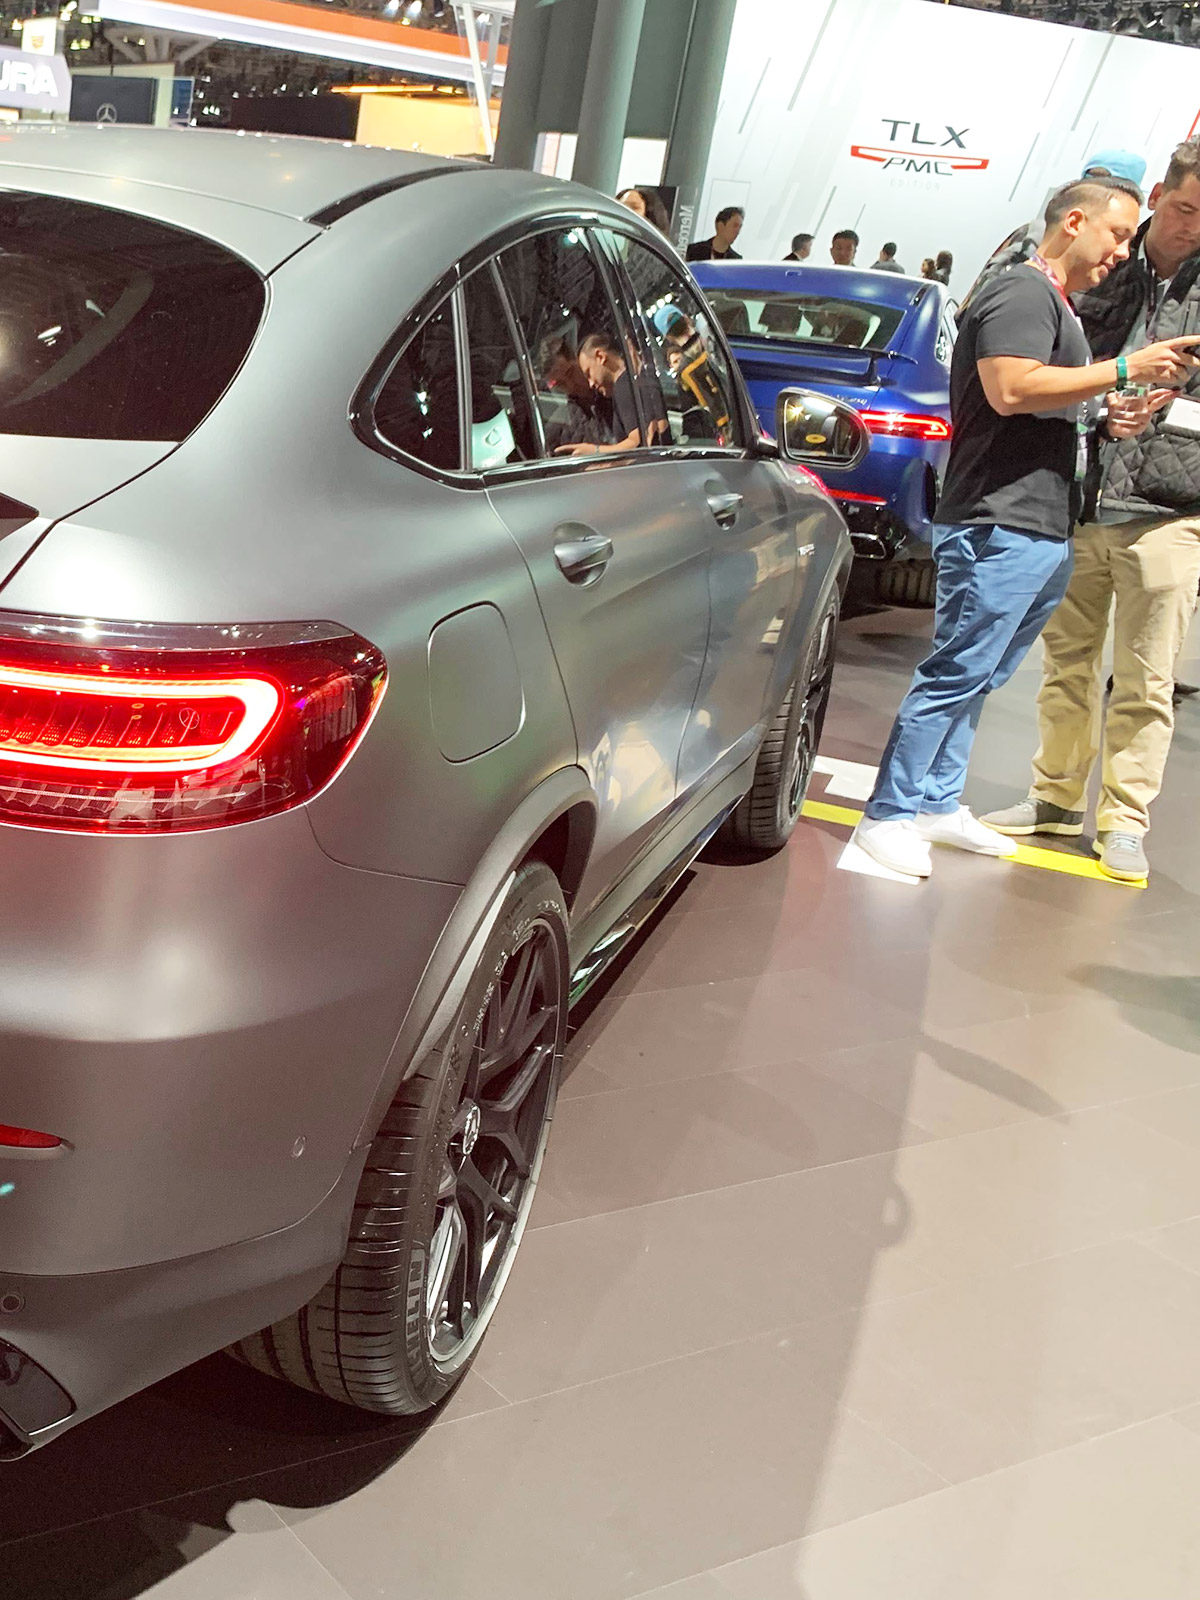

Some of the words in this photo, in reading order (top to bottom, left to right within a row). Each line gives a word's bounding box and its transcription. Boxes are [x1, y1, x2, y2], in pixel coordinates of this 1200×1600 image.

[881, 118, 970, 149] TLX
[882, 157, 953, 176] PMC
[889, 178, 941, 191] EDITION
